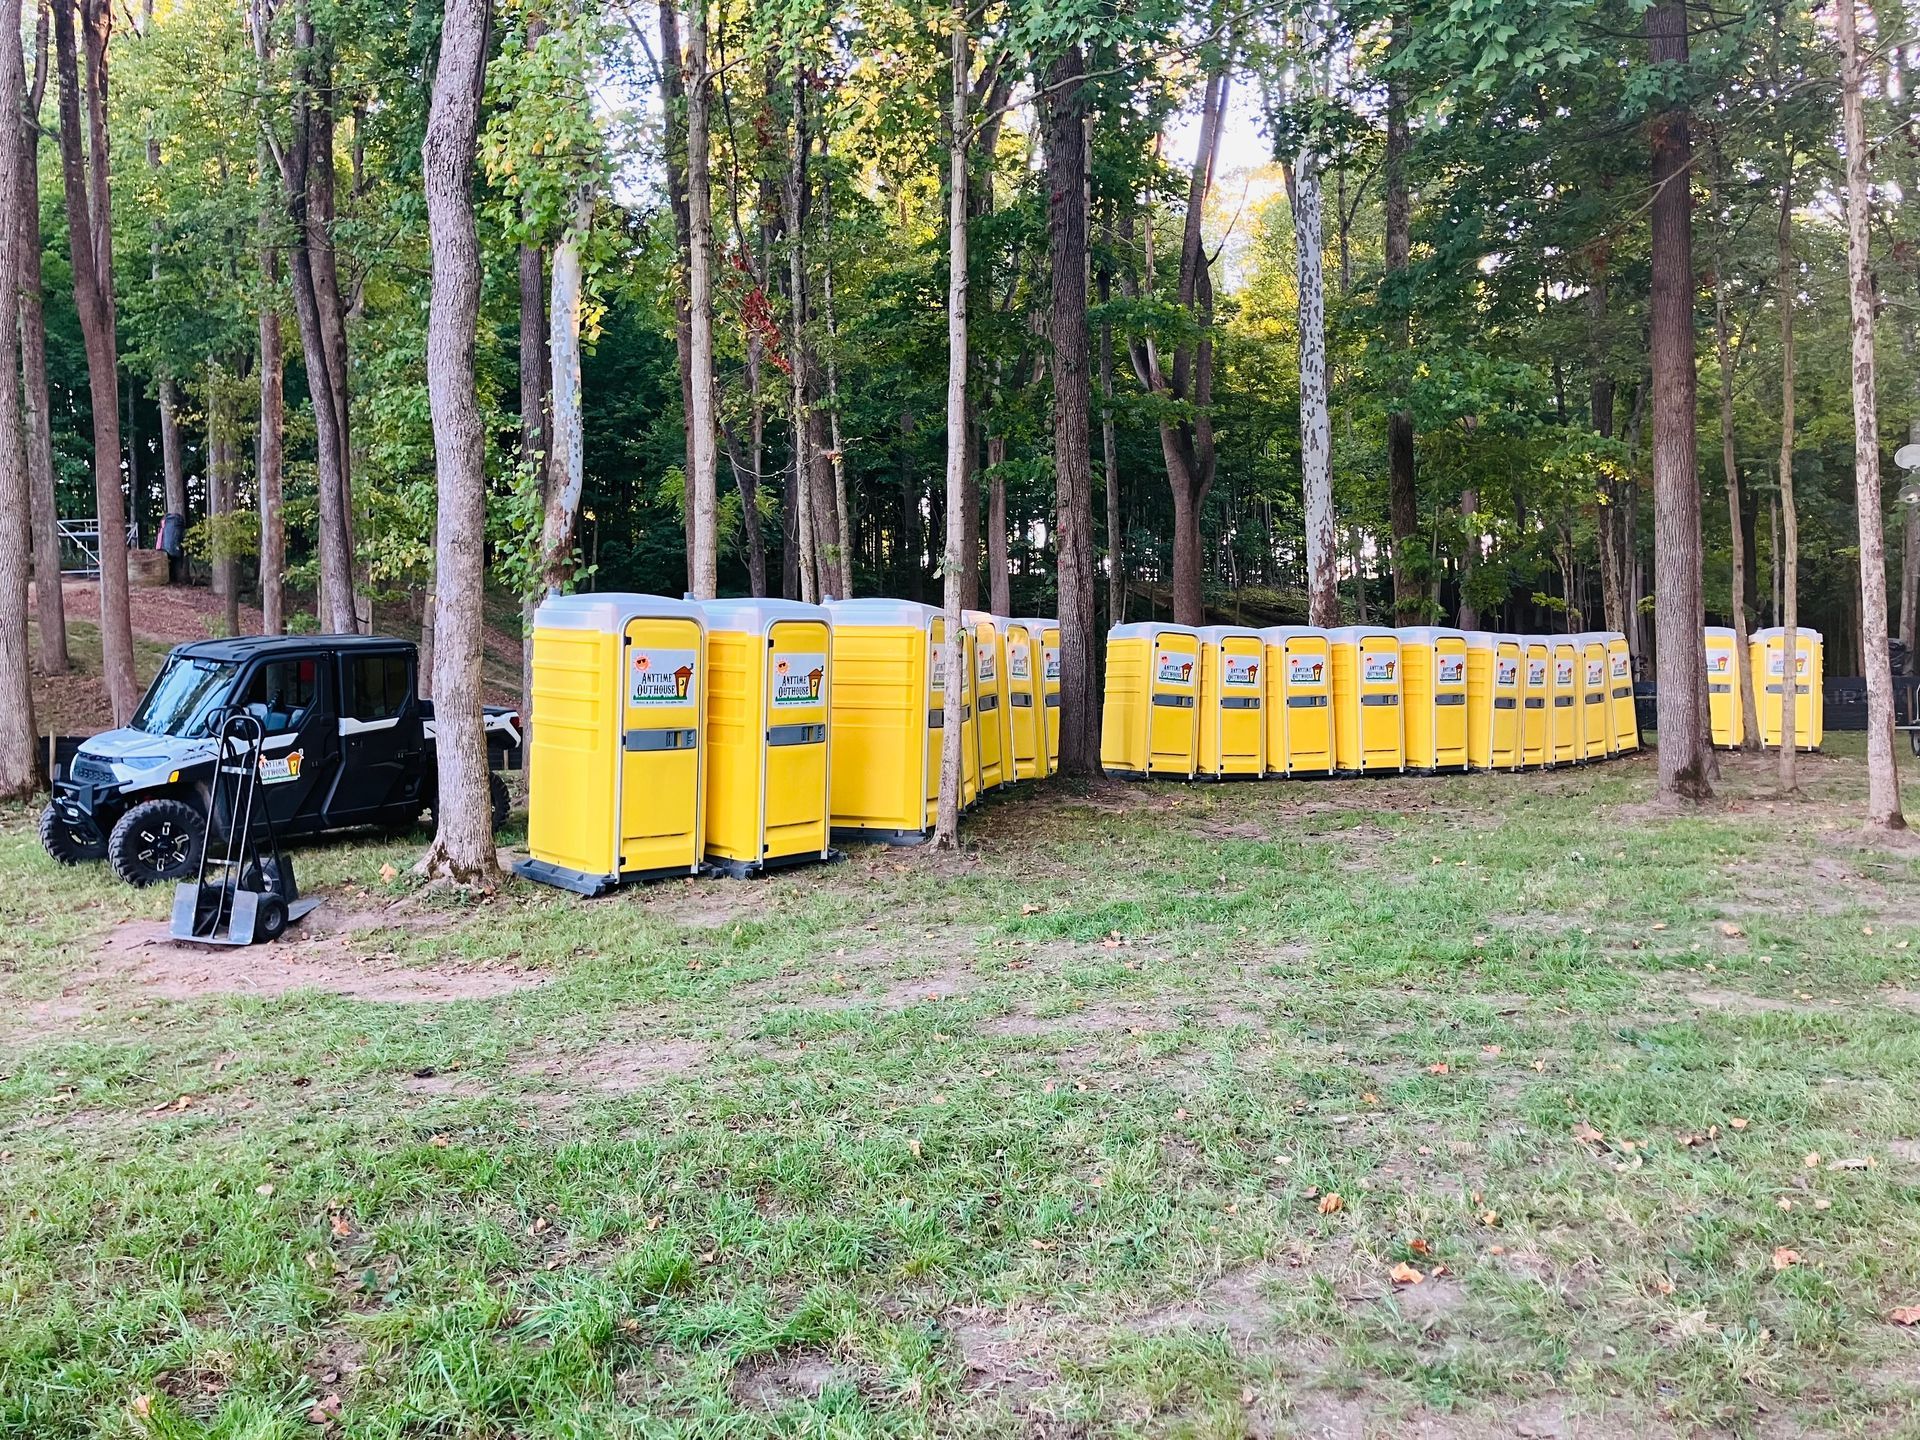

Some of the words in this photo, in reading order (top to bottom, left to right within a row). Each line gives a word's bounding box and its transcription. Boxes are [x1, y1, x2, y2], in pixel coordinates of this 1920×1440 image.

[641, 672, 673, 684] ANYTIME
[781, 675, 807, 686] ANYTIME
[637, 684, 676, 696] OUTHOUSE
[778, 686, 809, 697] OUTHOUSE
